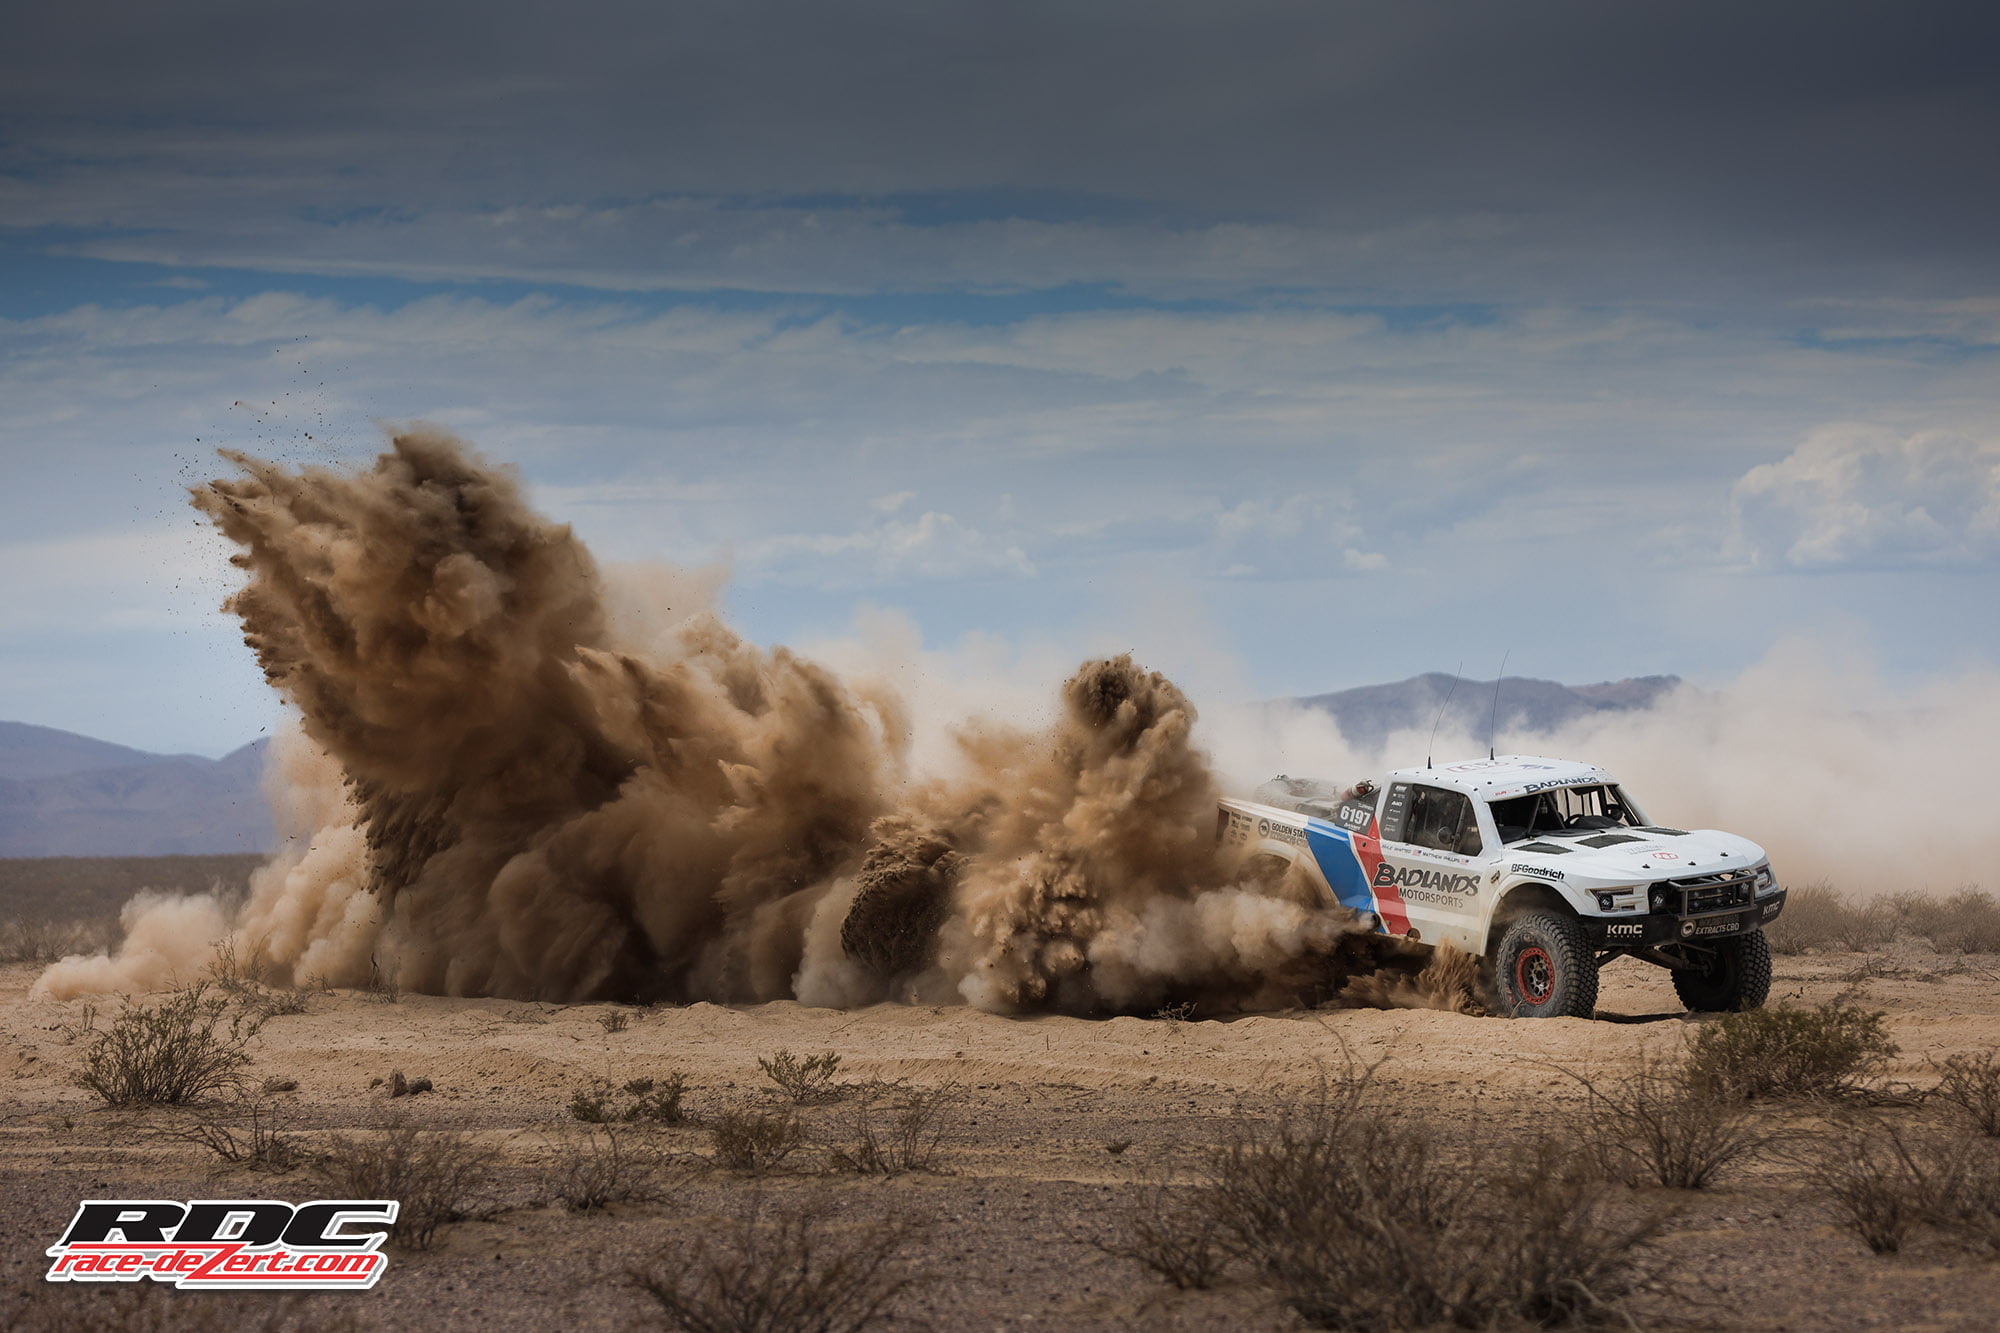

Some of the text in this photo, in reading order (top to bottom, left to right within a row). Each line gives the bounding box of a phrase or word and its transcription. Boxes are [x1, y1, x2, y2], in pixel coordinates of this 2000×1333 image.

[1523, 776, 1600, 794] BADLANDS
[1340, 805, 1371, 827] 6197
[1272, 822, 1293, 836] GOLDEN
[1373, 863, 1481, 896] BADLANDS
[1511, 863, 1565, 880] BFGoodrich
[1399, 887, 1464, 909] MOTORSPORTS
[1762, 900, 1781, 916] KMC
[1606, 924, 1644, 935] KMC
[1695, 922, 1740, 935] EXTRACTS CBD
